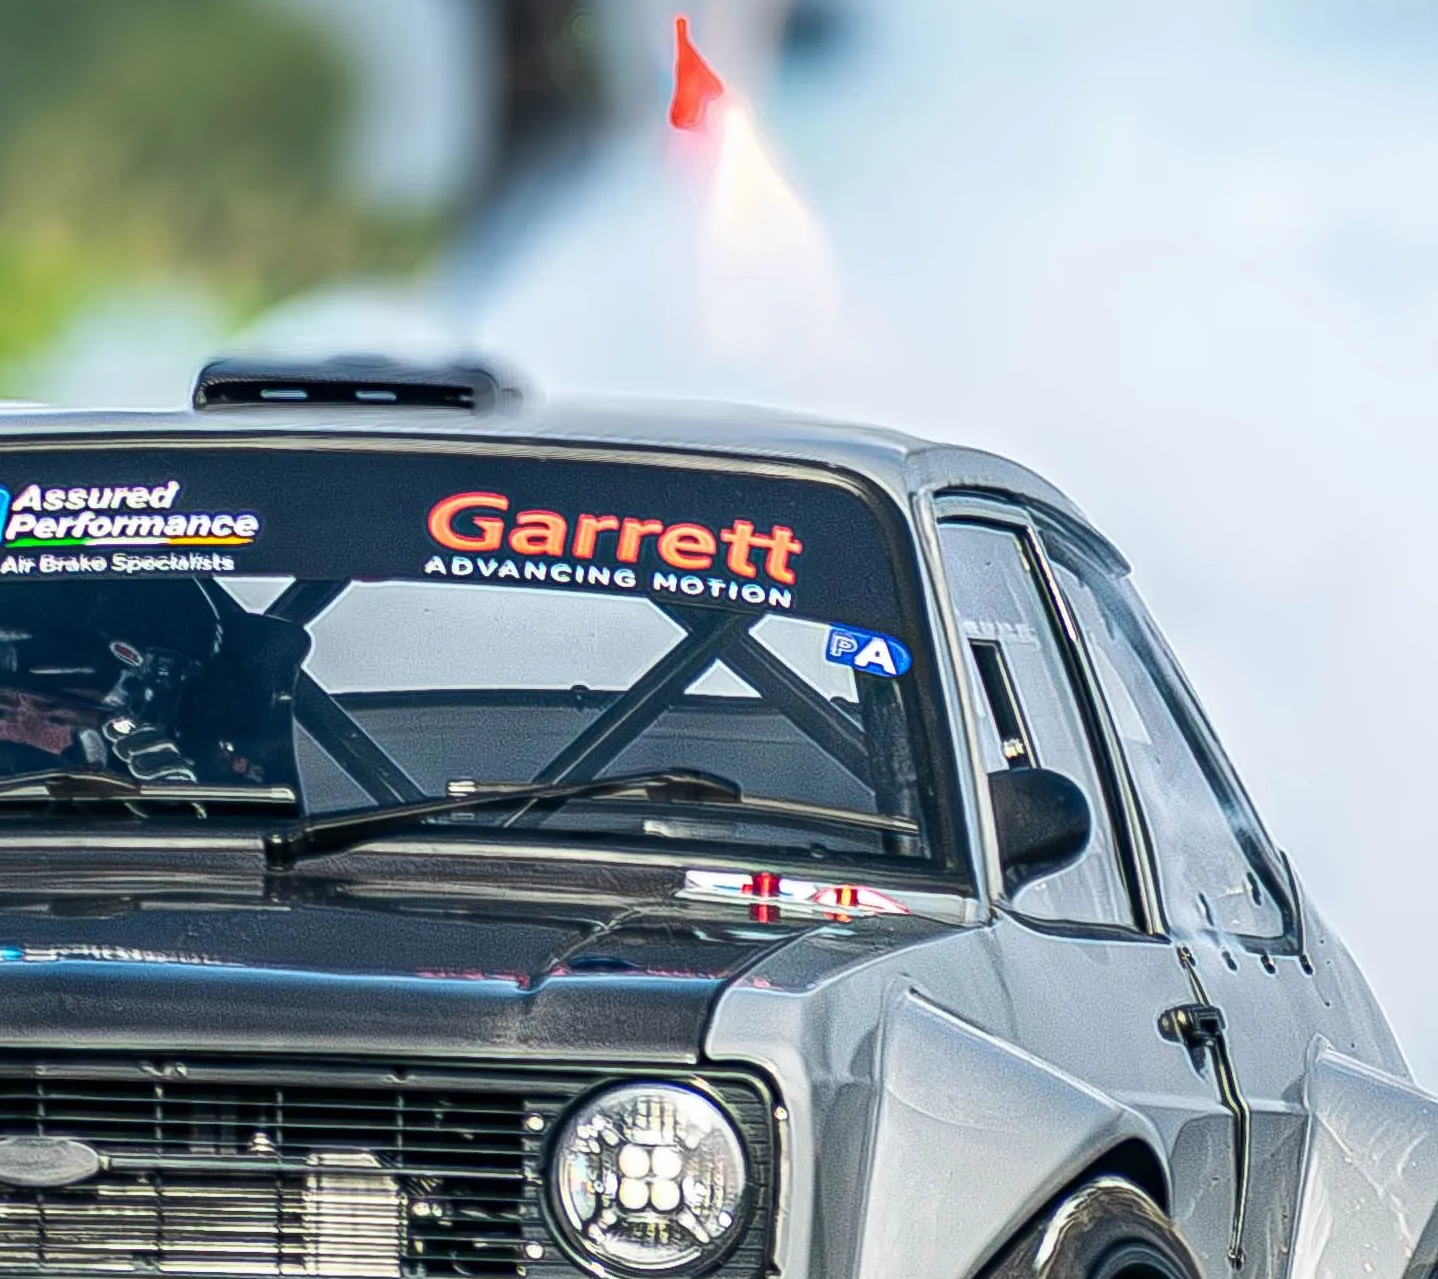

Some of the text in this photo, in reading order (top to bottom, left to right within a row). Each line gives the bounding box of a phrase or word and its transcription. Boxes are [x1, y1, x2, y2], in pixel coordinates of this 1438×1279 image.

[11, 480, 180, 511] Assured
[5, 511, 259, 540] Performance
[427, 491, 802, 585] Garrett
[0, 555, 36, 575] Air
[39, 553, 108, 573] Brake
[111, 551, 236, 574] Specialists
[424, 555, 793, 609] ADVANCING MOTION
